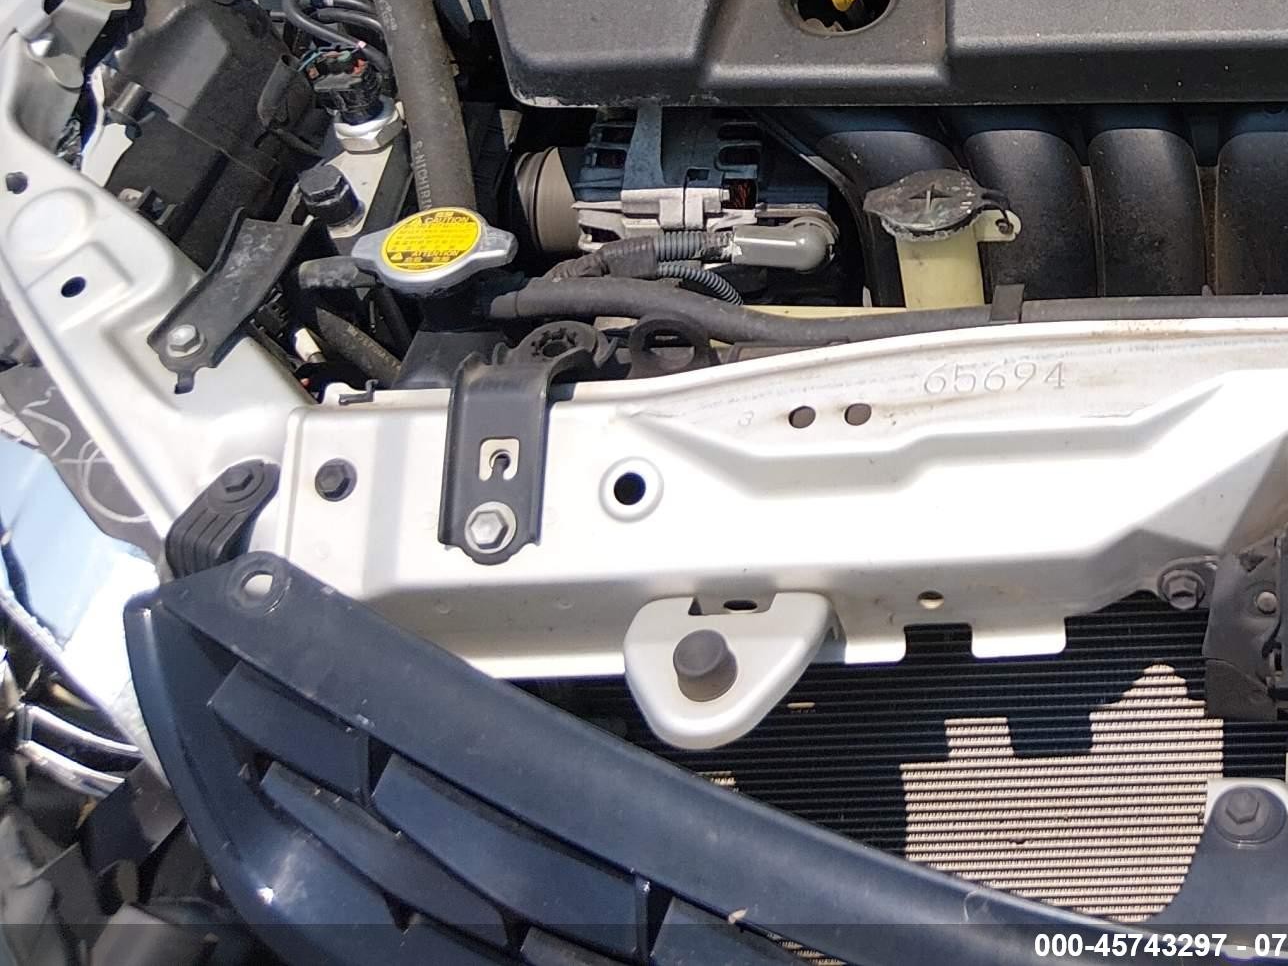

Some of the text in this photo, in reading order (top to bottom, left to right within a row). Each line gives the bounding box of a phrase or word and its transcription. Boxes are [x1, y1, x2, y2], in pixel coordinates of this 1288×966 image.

[424, 216, 470, 224] CAUTION
[411, 250, 460, 258] ATTENTION
[923, 361, 1067, 396] 65694
